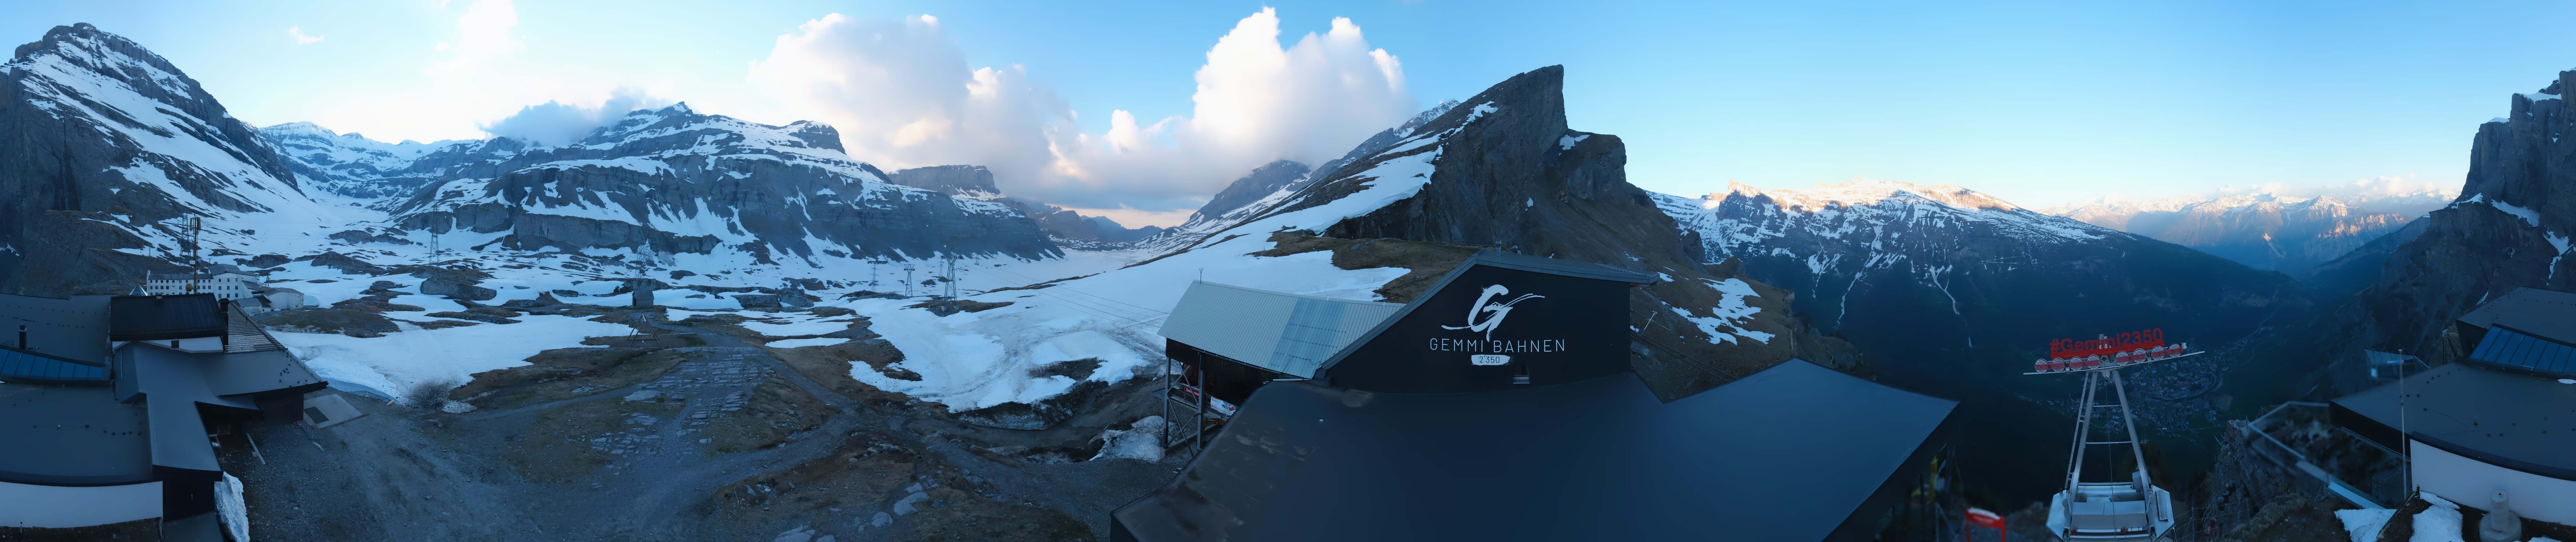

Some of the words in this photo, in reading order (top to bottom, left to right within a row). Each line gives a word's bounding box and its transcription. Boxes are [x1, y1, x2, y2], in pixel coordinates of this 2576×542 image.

[1430, 338, 1483, 352] GEMMI
[1494, 339, 1564, 353] BAHNEN
[2050, 328, 2163, 353] #Gemmi2350
